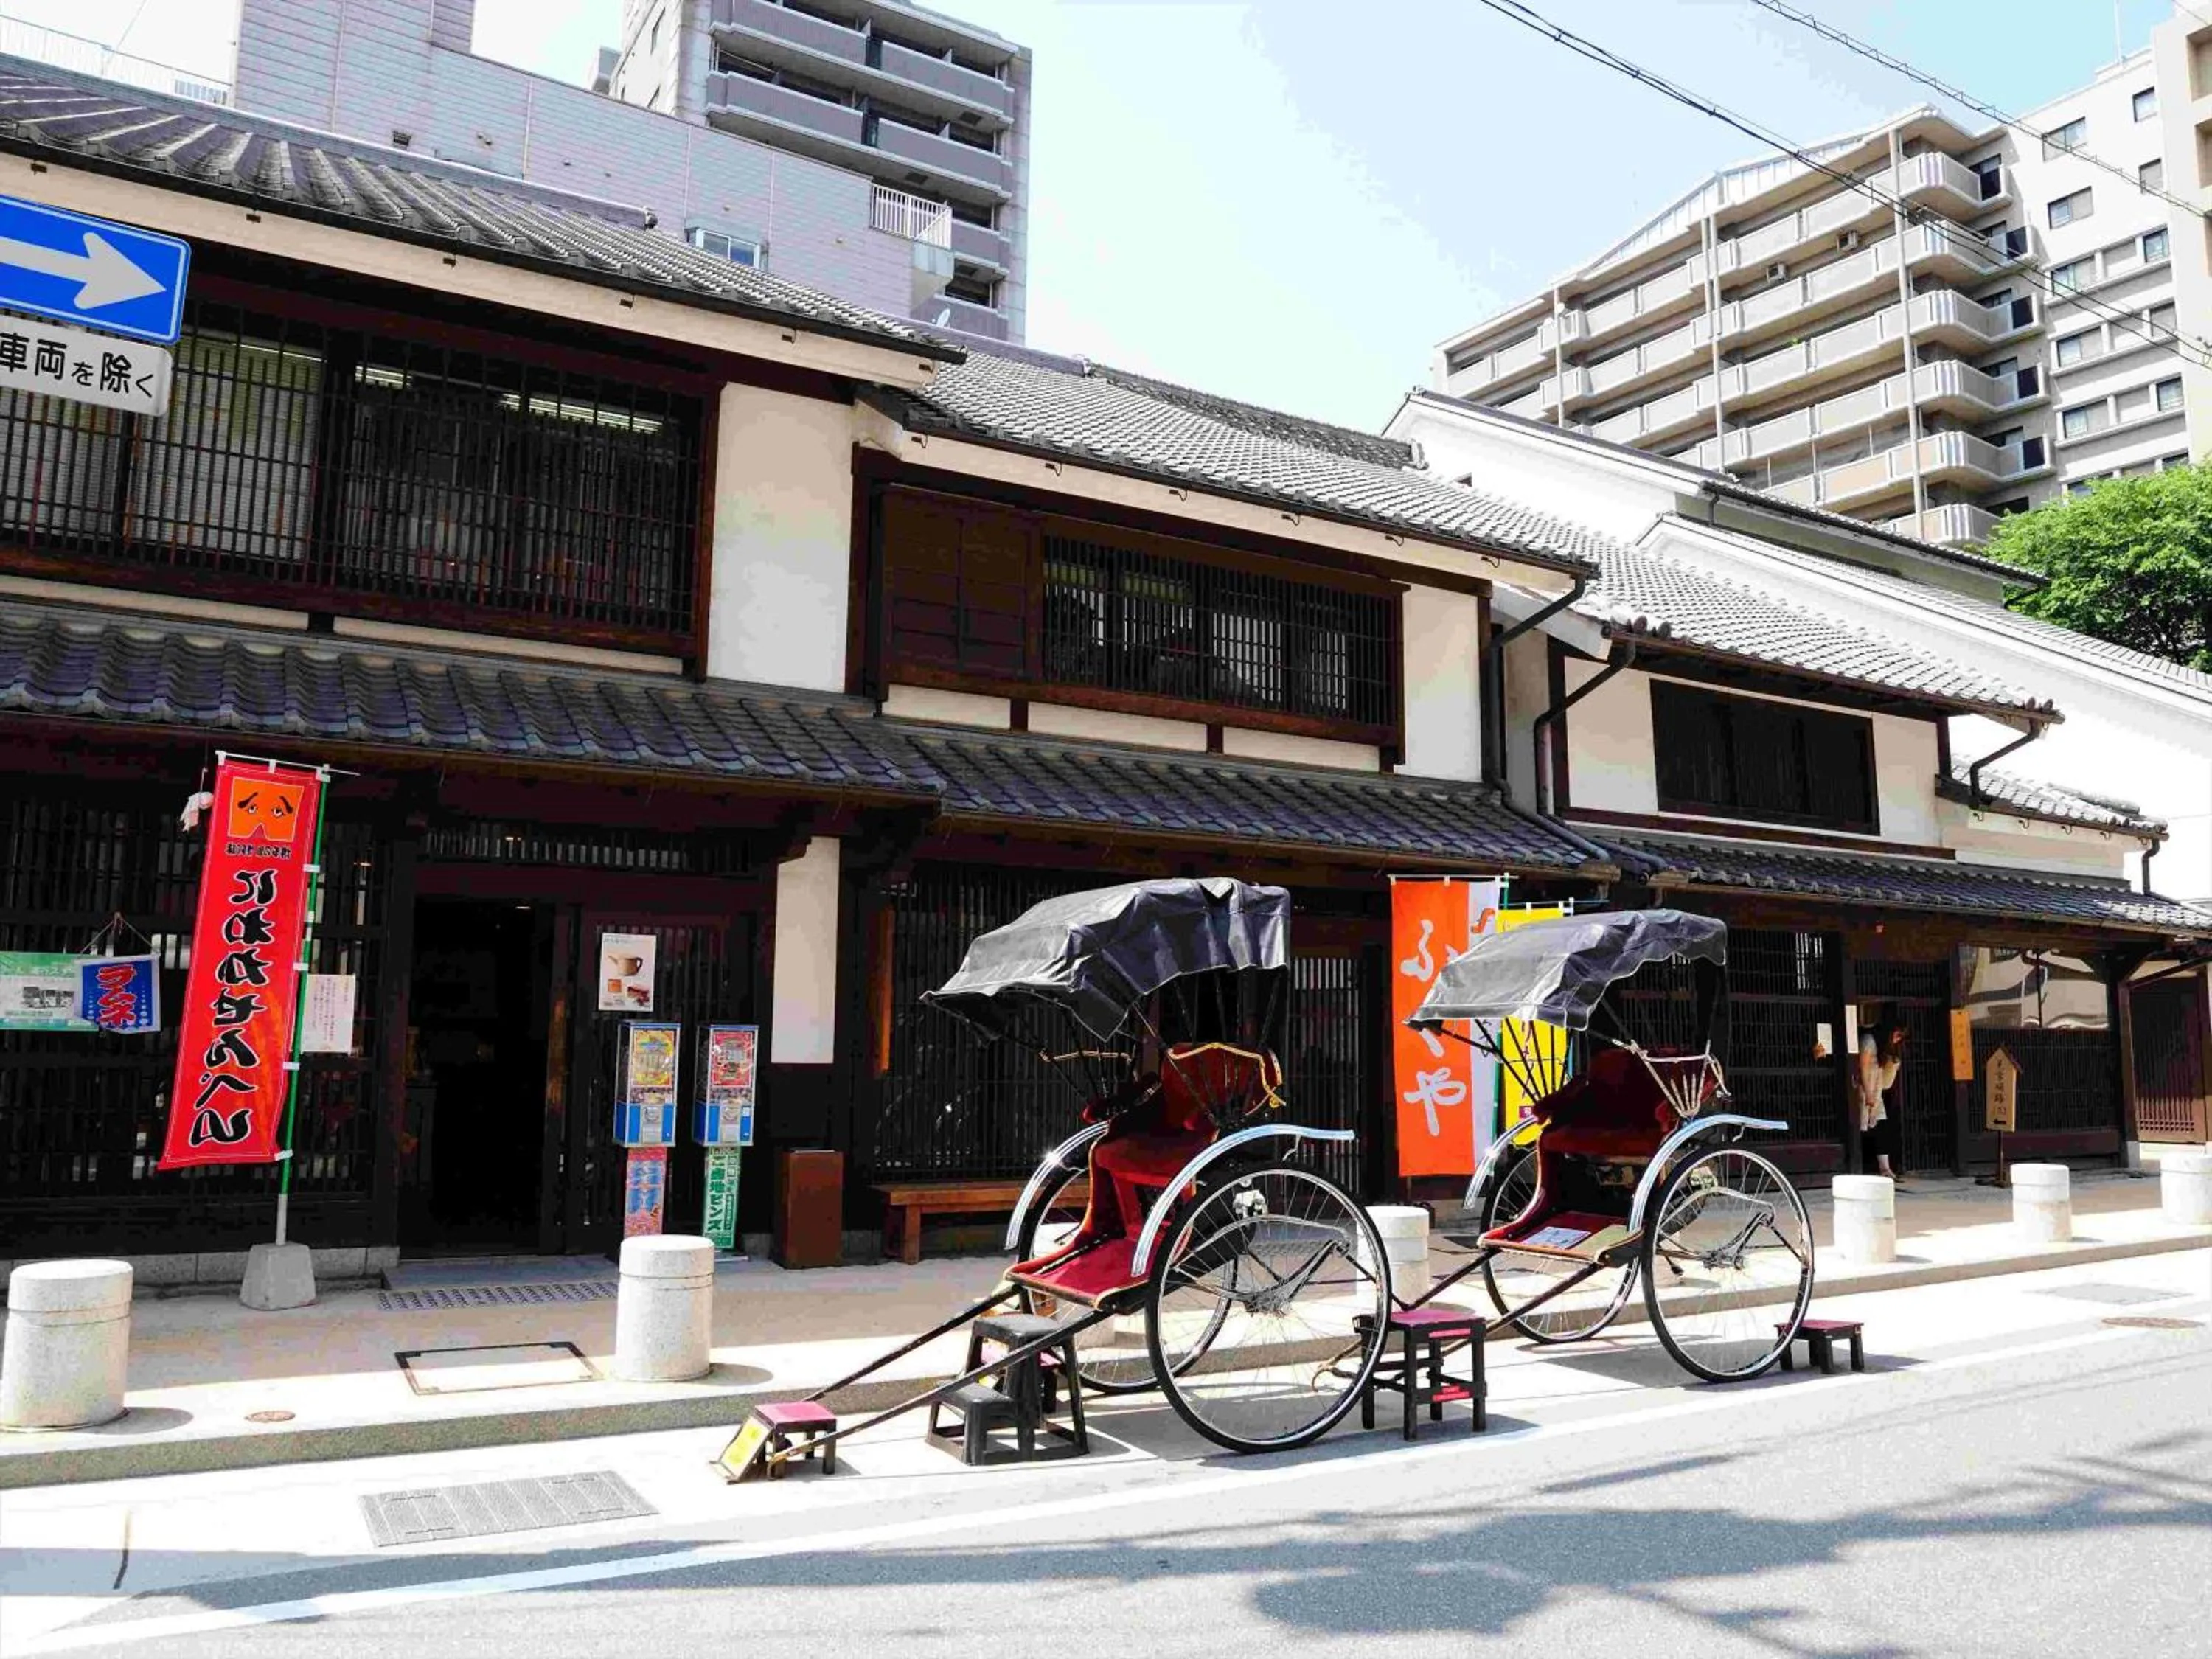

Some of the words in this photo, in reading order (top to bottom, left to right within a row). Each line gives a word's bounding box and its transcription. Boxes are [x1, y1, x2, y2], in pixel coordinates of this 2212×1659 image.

[0, 333, 153, 398] 車両を除く
[96, 964, 138, 1026] ラムネ
